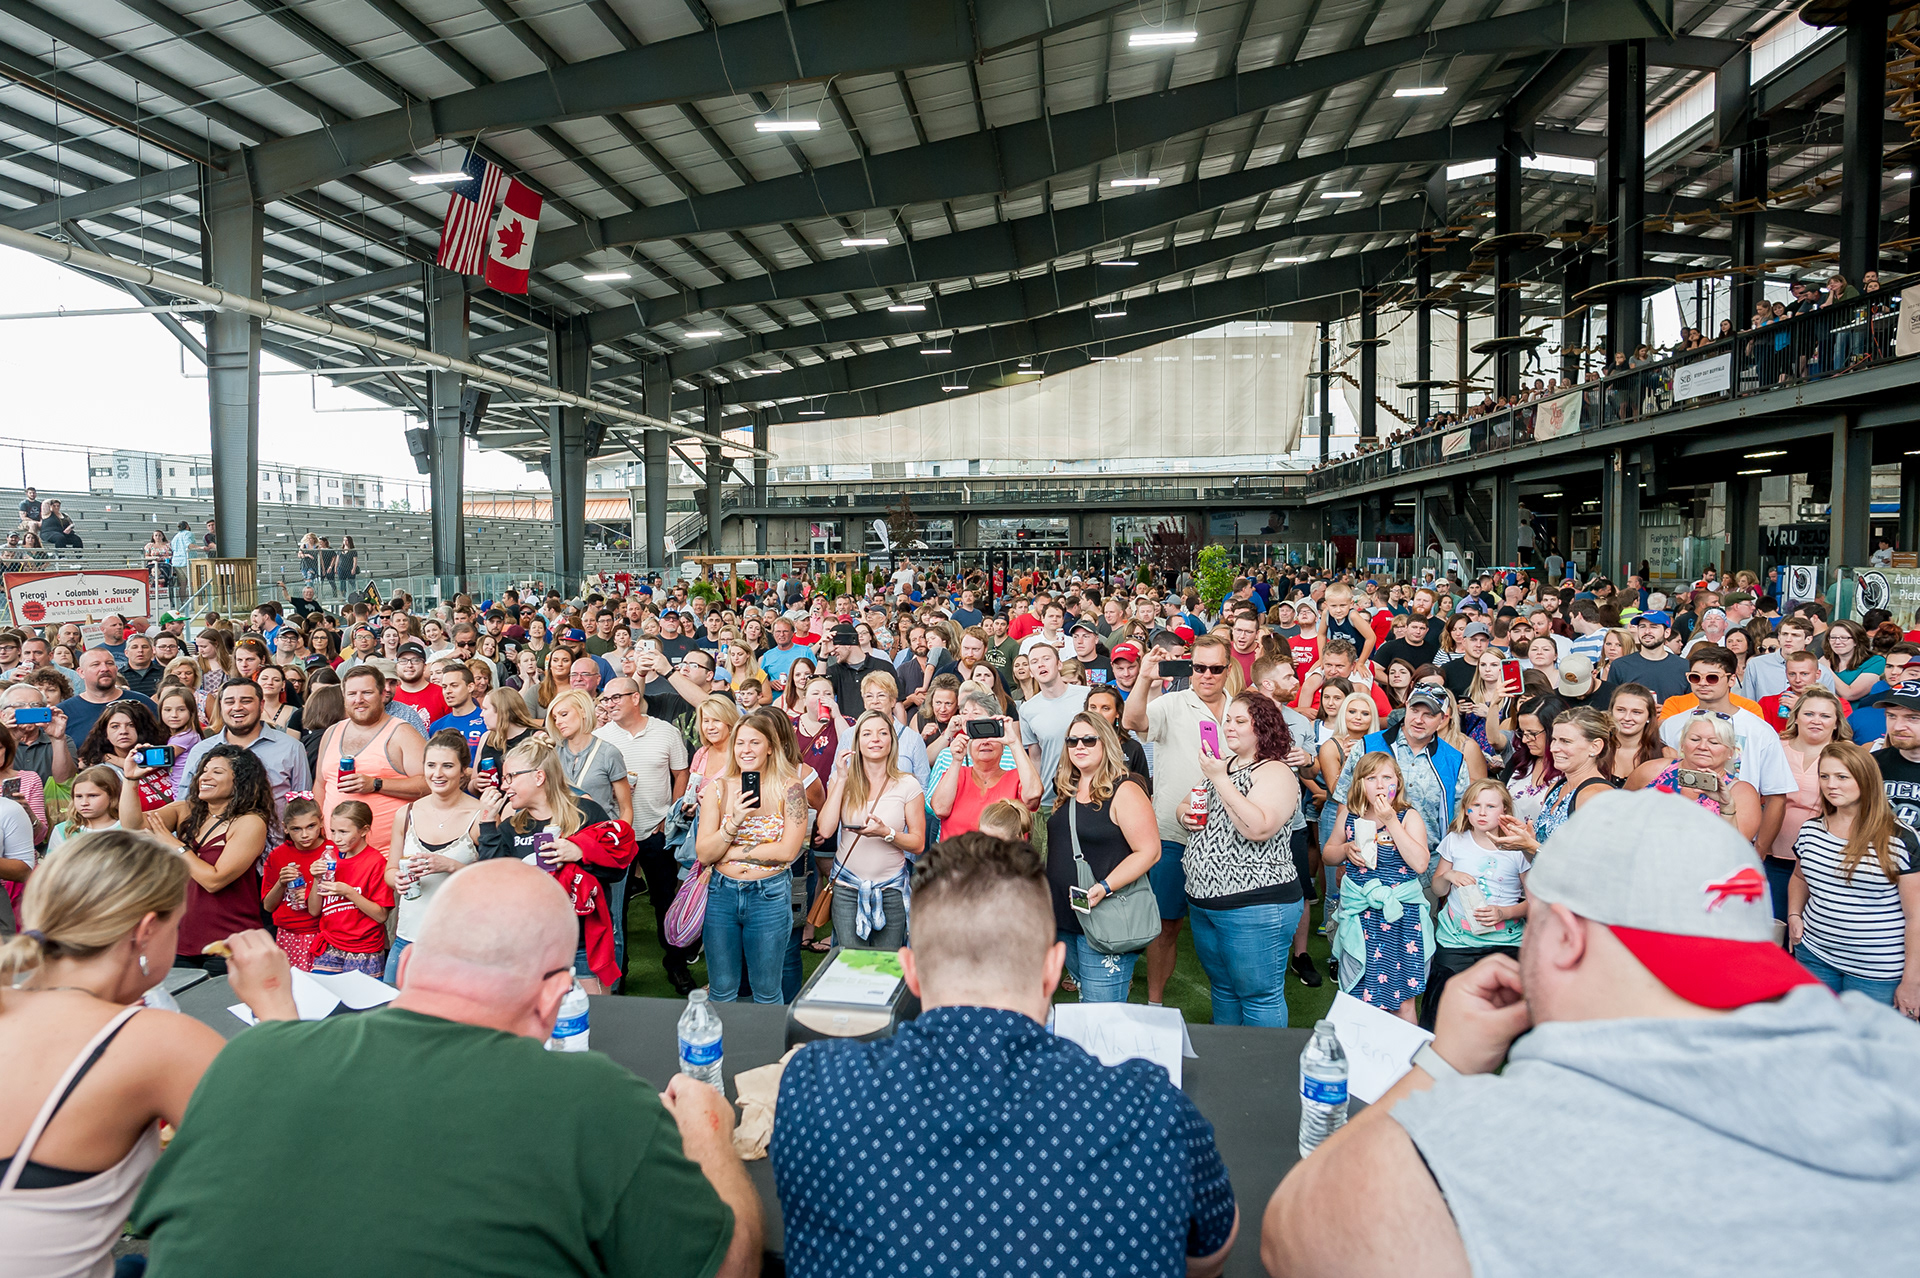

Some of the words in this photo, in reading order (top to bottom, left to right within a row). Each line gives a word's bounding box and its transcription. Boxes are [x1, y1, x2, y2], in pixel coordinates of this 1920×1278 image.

[116, 458, 130, 479] 301
[1651, 547, 1670, 557] enegy
[20, 591, 48, 601] Pierogi
[65, 588, 99, 597] Golombki
[112, 587, 139, 596] Sausage
[46, 600, 75, 608] POTTS
[1884, 780, 1920, 800] OCK
[514, 835, 535, 847] BUF
[1082, 1022, 1160, 1058] Matt
